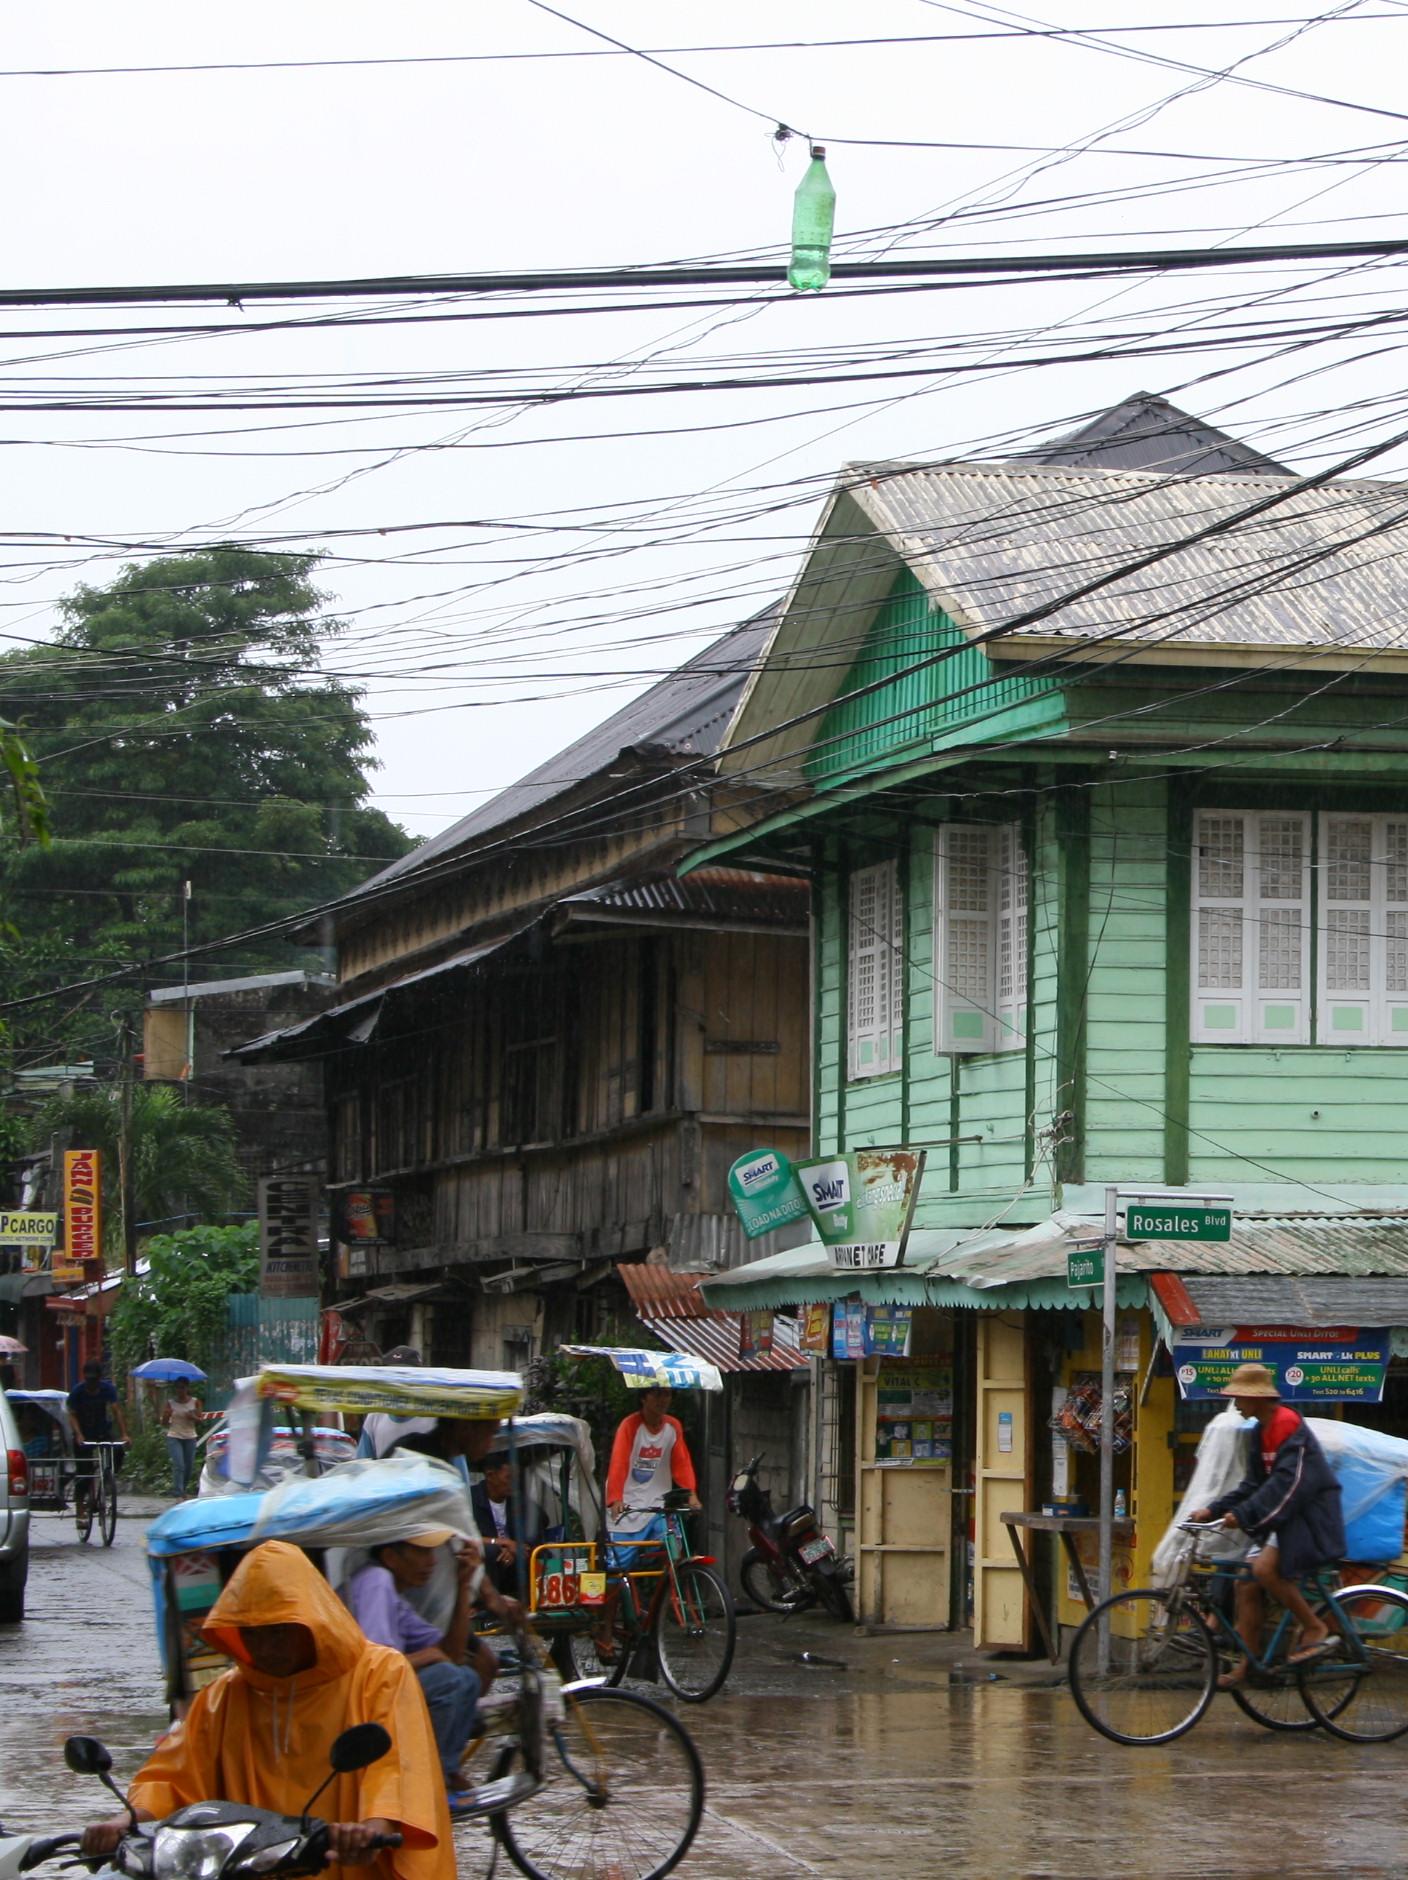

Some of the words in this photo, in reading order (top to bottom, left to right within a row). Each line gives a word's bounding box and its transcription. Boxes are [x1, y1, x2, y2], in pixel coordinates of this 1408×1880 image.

[743, 1161, 773, 1182] SMART
[750, 1213, 770, 1231] LOAD
[769, 1207, 783, 1221] NA
[781, 1198, 801, 1215] DITO
[10, 1218, 55, 1233] CARGO
[1133, 1215, 1199, 1233] Rosales
[1205, 1216, 1226, 1226] Blvd
[71, 1207, 94, 1258] BURGER
[1070, 1258, 1094, 1280] Pajarito
[1182, 1328, 1224, 1337] SMART
[1252, 1329, 1288, 1337] SPECIAL
[1290, 1329, 1312, 1338] UNLI
[1241, 1348, 1263, 1360] UNLI
[1355, 1351, 1380, 1360] PLUS
[1198, 1366, 1219, 1374] UNLI
[1320, 1366, 1341, 1374] UNLI
[884, 1376, 912, 1387] VITAL
